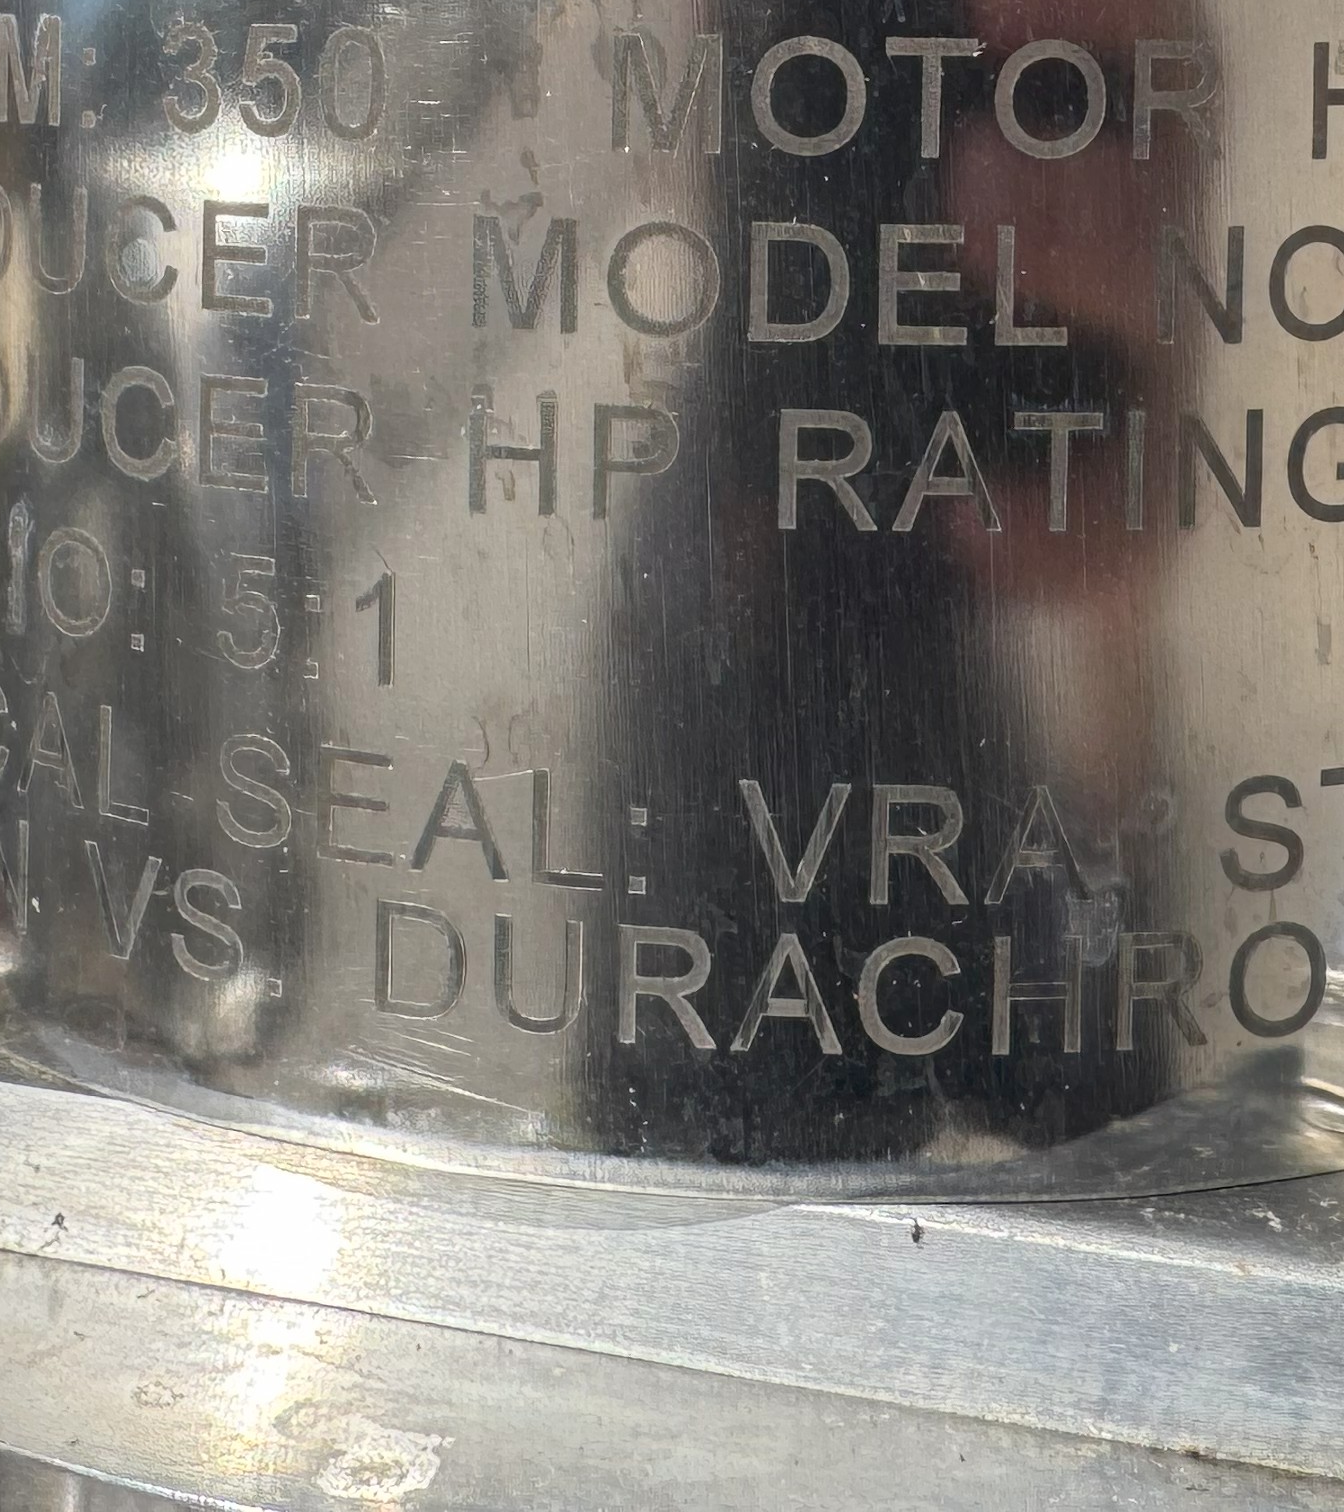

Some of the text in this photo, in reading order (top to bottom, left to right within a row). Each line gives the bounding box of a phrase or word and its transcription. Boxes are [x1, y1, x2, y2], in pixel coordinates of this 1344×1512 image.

[162, 20, 387, 141] 350
[610, 32, 1220, 161] MOTOR
[470, 215, 1067, 346] MODEL
[467, 386, 680, 520] HP
[216, 554, 396, 688] 5:1
[216, 731, 648, 896] SEAL:
[738, 778, 1093, 907] VRA
[84, 839, 282, 998] VS.
